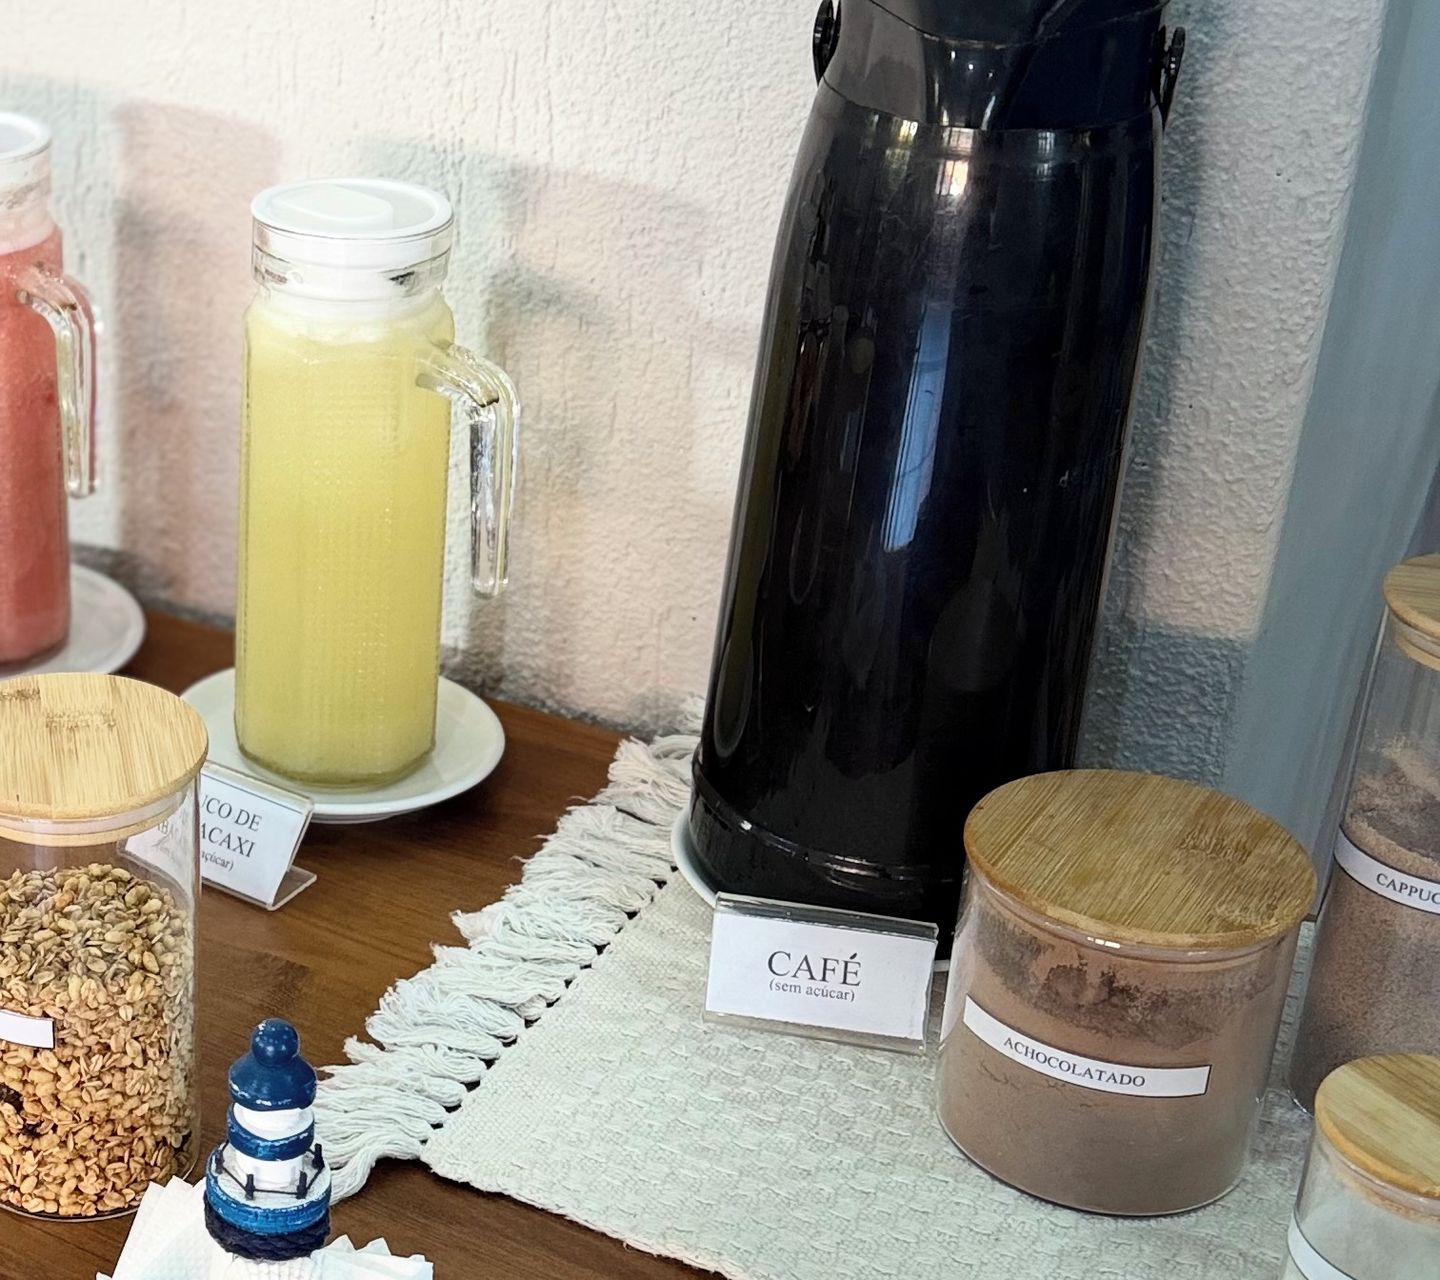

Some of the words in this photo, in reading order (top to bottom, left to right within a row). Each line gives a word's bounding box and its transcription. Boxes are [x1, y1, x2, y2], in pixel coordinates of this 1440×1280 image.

[234, 807, 263, 833] DE
[767, 951, 862, 987] CAFÉ
[769, 977, 802, 994] (sem
[805, 984, 855, 1003] açúcar)
[1003, 1037, 1146, 1088] ACHOCOLATADO
